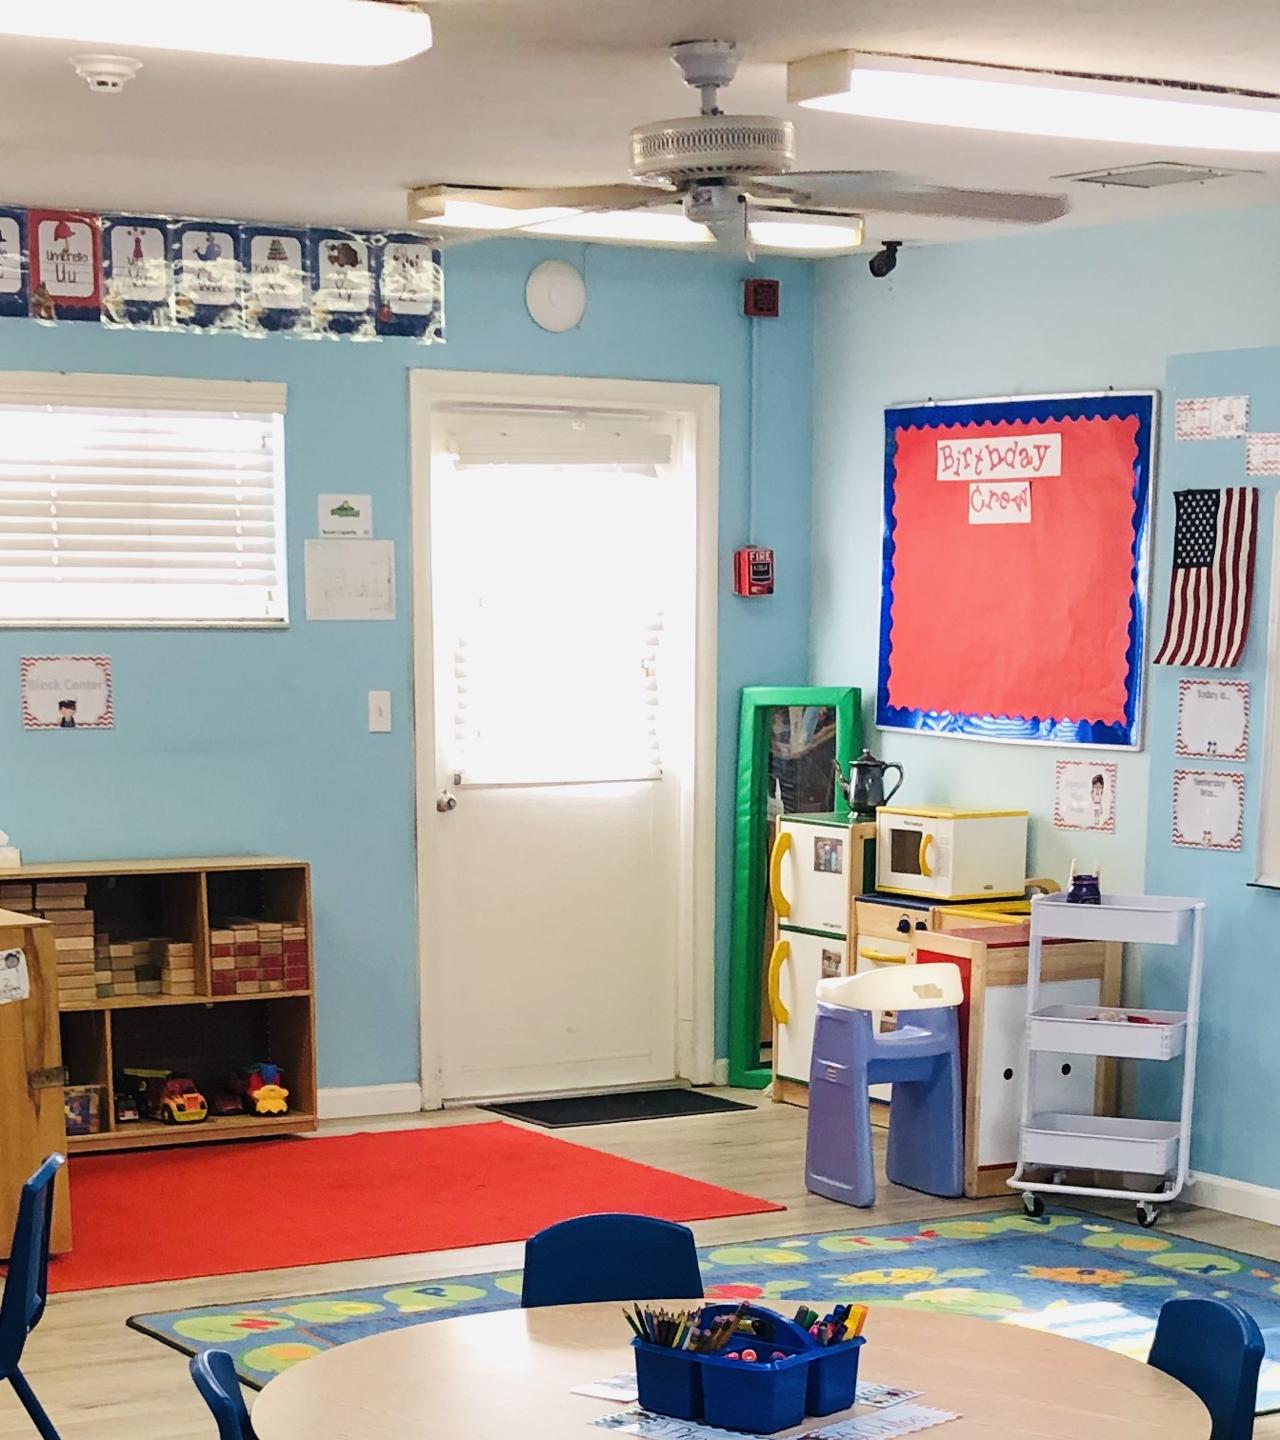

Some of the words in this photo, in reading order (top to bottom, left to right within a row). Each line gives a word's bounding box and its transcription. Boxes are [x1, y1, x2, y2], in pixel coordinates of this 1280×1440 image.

[54, 264, 77, 284] Uu
[939, 440, 1051, 477] Birthday
[970, 485, 1029, 513] Crew
[750, 551, 771, 561] FIRE
[29, 679, 62, 692] Block
[64, 679, 104, 692] Center
